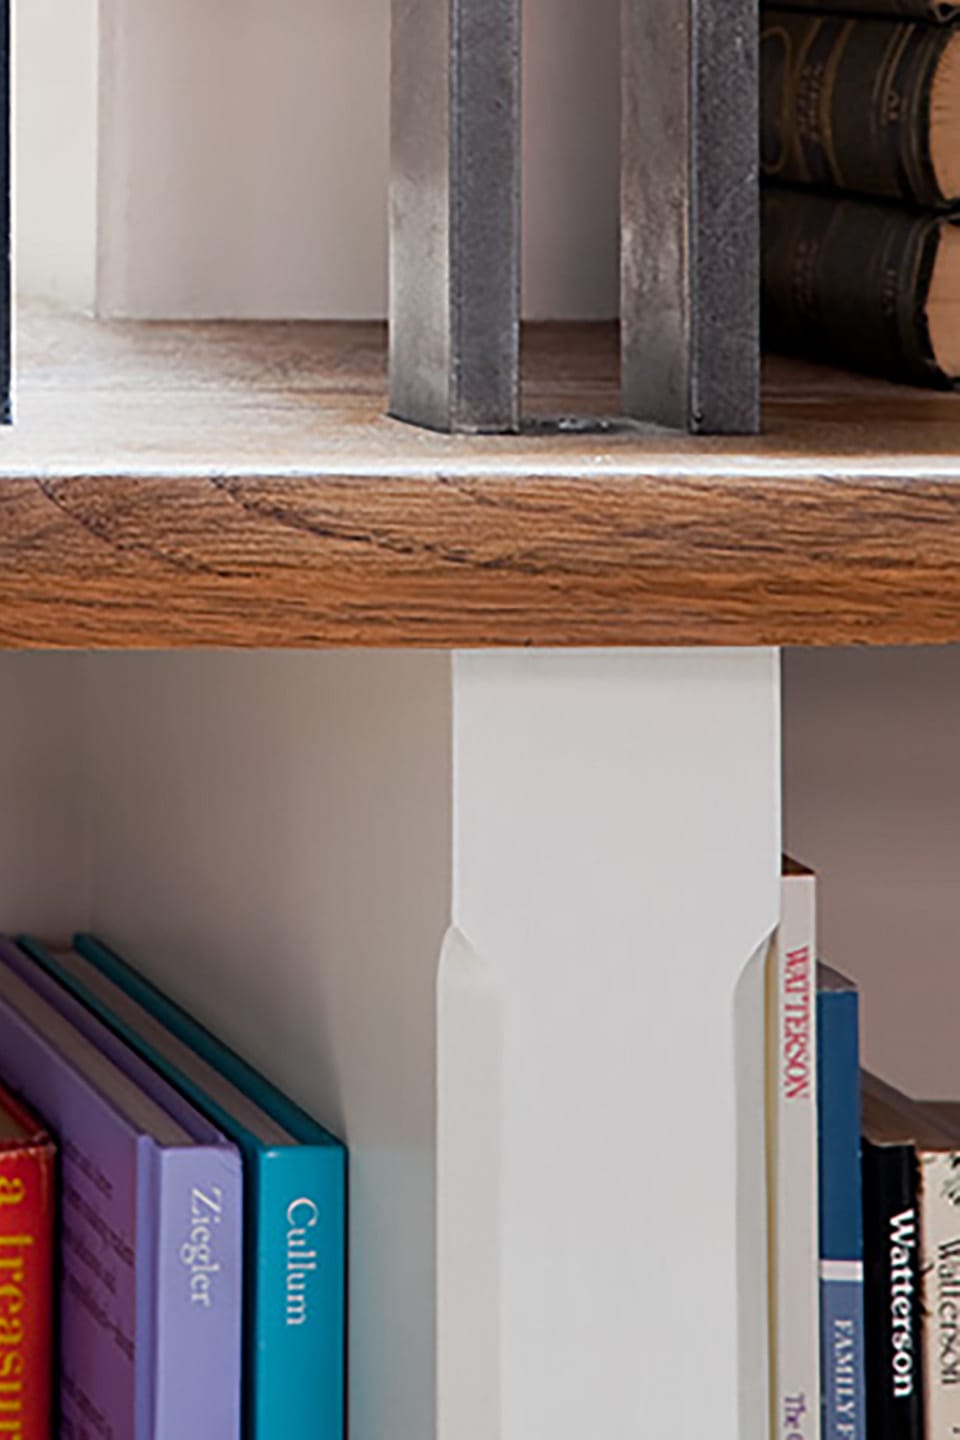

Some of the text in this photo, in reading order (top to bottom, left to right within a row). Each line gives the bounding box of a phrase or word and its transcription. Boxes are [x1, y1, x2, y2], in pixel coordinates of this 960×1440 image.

[784, 945, 809, 1099] WATTERSON
[180, 1186, 221, 1307] Ziegler
[287, 1197, 318, 1325] Cullum
[890, 1209, 915, 1397] Watterson
[785, 1394, 806, 1429] The
[834, 1319, 855, 1419] FAMILY
